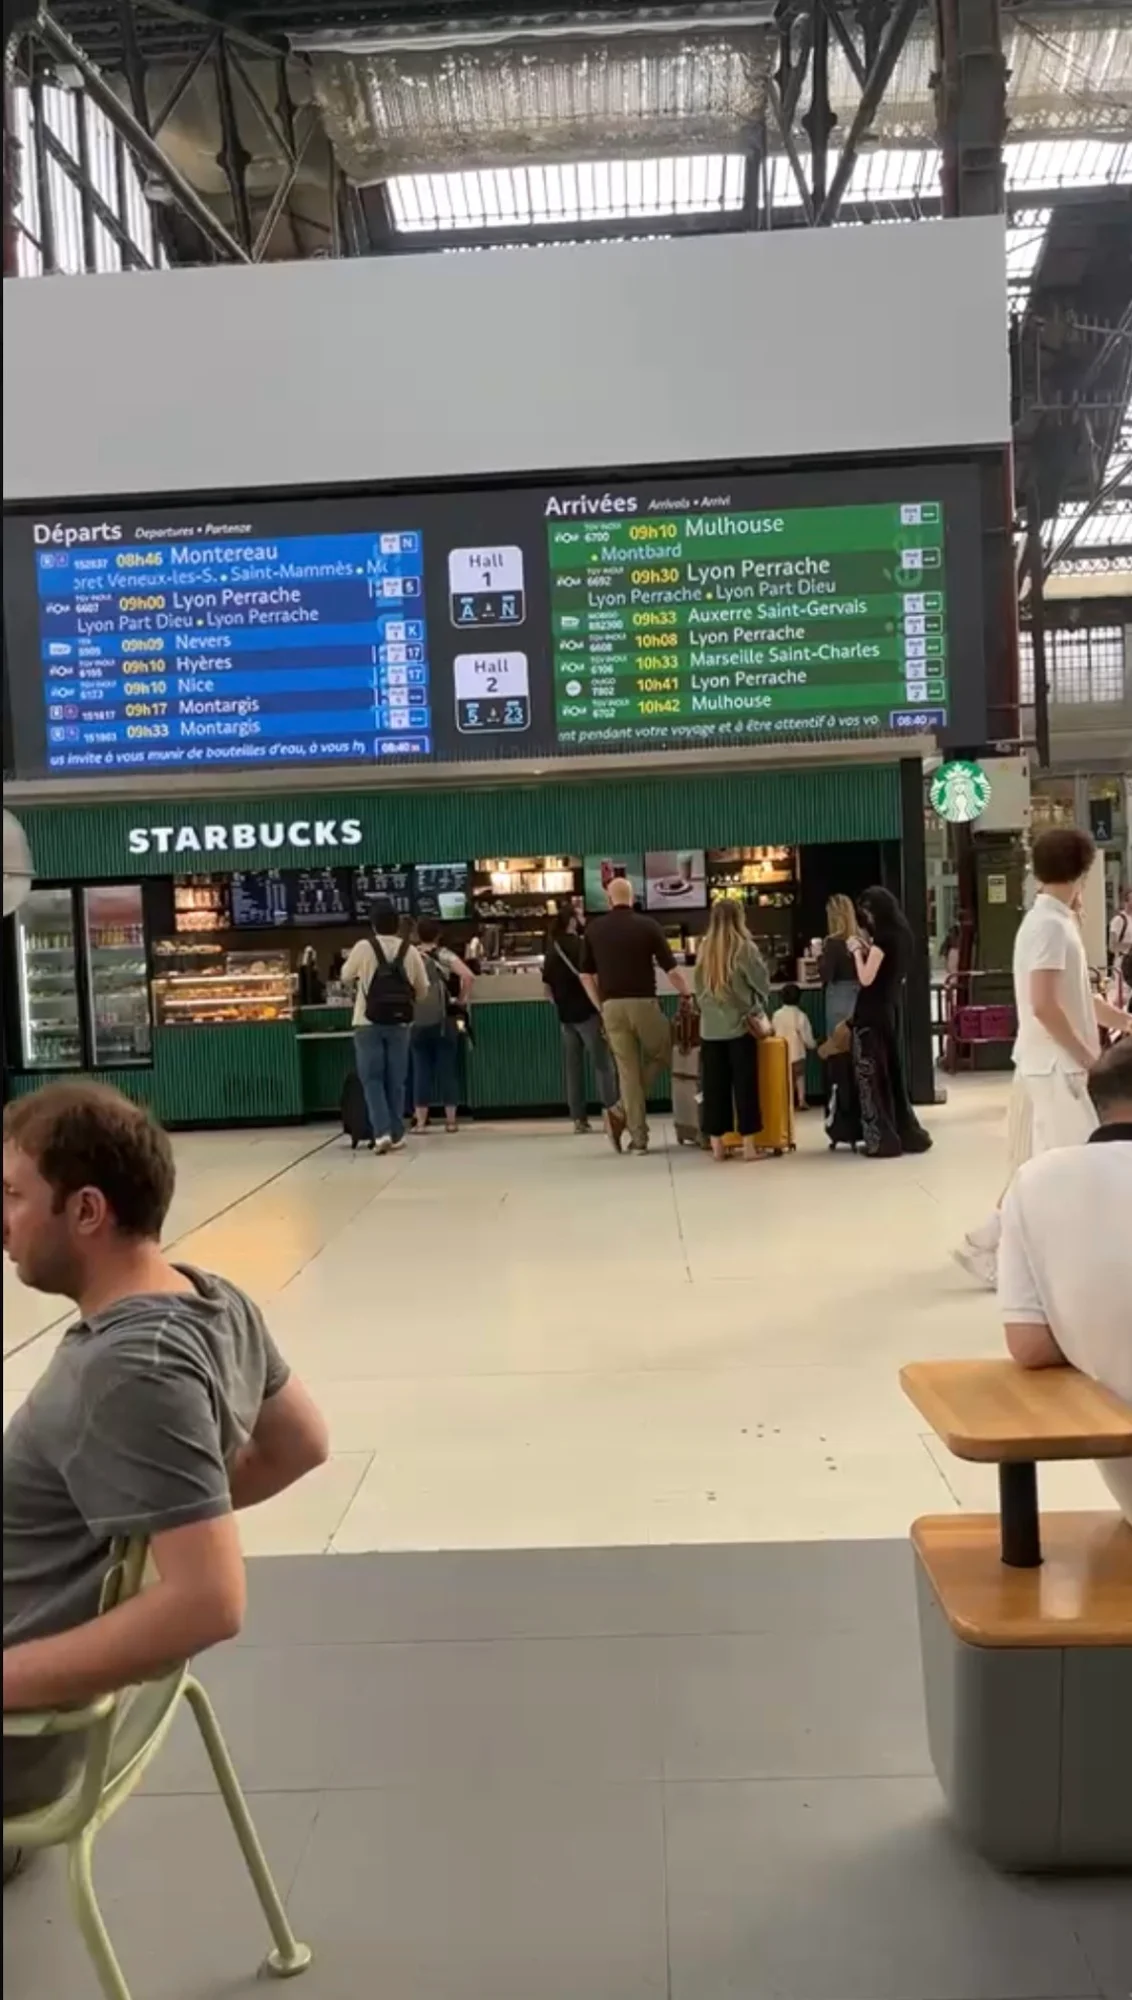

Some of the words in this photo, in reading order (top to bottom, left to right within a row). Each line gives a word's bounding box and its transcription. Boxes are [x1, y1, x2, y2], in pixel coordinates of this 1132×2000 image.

[544, 494, 638, 516] Arrivées
[648, 499, 690, 511] Arrivals
[701, 496, 731, 507] Arrivi
[33, 522, 122, 548] Départs
[134, 526, 194, 540] Departures
[205, 522, 252, 535] Partenze
[630, 524, 678, 540] 09h10
[685, 517, 784, 537] Mulhouse
[402, 537, 412, 549] N
[602, 544, 682, 561] Montbard
[116, 552, 163, 568] 08h46
[170, 545, 278, 565] Montereau
[469, 553, 504, 568] Hall
[108, 568, 218, 588] Veneux-les-S.
[231, 561, 352, 581] Saint-Mammès
[482, 572, 492, 587] 1
[631, 568, 679, 585] 09h30
[688, 564, 735, 585] Lyon
[742, 556, 830, 578] Perrache
[119, 596, 166, 611] 09h00
[172, 592, 216, 612] Lyon
[222, 586, 301, 606] Perrache
[588, 592, 626, 610] Lyon
[631, 586, 702, 604] Perrache
[716, 585, 754, 603] Lyon
[760, 581, 792, 597] Part
[798, 578, 836, 594] Dieu
[462, 604, 474, 618] A
[502, 602, 515, 616] N
[632, 612, 678, 626] 09h33
[688, 608, 752, 624] Auxerre
[757, 600, 868, 620] Saint-Gervais
[77, 618, 114, 636] Lyon
[120, 615, 152, 630] Part
[156, 612, 193, 628] Dieu
[206, 610, 244, 630] Lyon
[249, 606, 320, 624] Perrache
[408, 626, 418, 637] K
[122, 638, 164, 652] 09h09
[176, 634, 232, 650] Nevers
[636, 633, 678, 648] 10h08
[690, 630, 728, 648] Lyon
[734, 624, 806, 642] Perrache
[408, 646, 420, 659] 17
[636, 656, 678, 670] 10h33
[690, 650, 764, 667] Marseille
[768, 644, 880, 662] Saint-Charles
[122, 658, 166, 674] 09h10
[176, 656, 232, 674] Hyères
[408, 668, 422, 680] 17
[474, 660, 508, 674] Hall
[124, 680, 167, 696] 09h10
[178, 678, 214, 694] Nice
[486, 677, 498, 693] 2
[636, 678, 678, 692] 10h41
[692, 674, 730, 690] Lyon
[735, 668, 806, 687] Perrache
[125, 702, 168, 717] 09h17
[178, 696, 260, 716] Montargis
[638, 700, 680, 714] 10h42
[692, 694, 772, 710] Mulhouse
[468, 708, 478, 724] 5
[504, 706, 524, 724] 23
[127, 724, 170, 739] 09h33
[180, 718, 261, 738] Montargis
[578, 726, 632, 743] pendant
[634, 726, 668, 738] votre
[671, 724, 716, 740] voyage
[718, 721, 732, 734] et
[746, 718, 772, 732] être
[774, 714, 827, 730] attentif
[838, 716, 860, 726] vos
[67, 752, 102, 764] invite
[116, 751, 144, 762] vous
[148, 748, 184, 761] munir
[186, 746, 204, 759] de
[206, 743, 266, 758] bouteilles
[269, 740, 306, 757] d'eau,
[320, 742, 350, 754] vous
[128, 819, 362, 854] STARBUCKS
